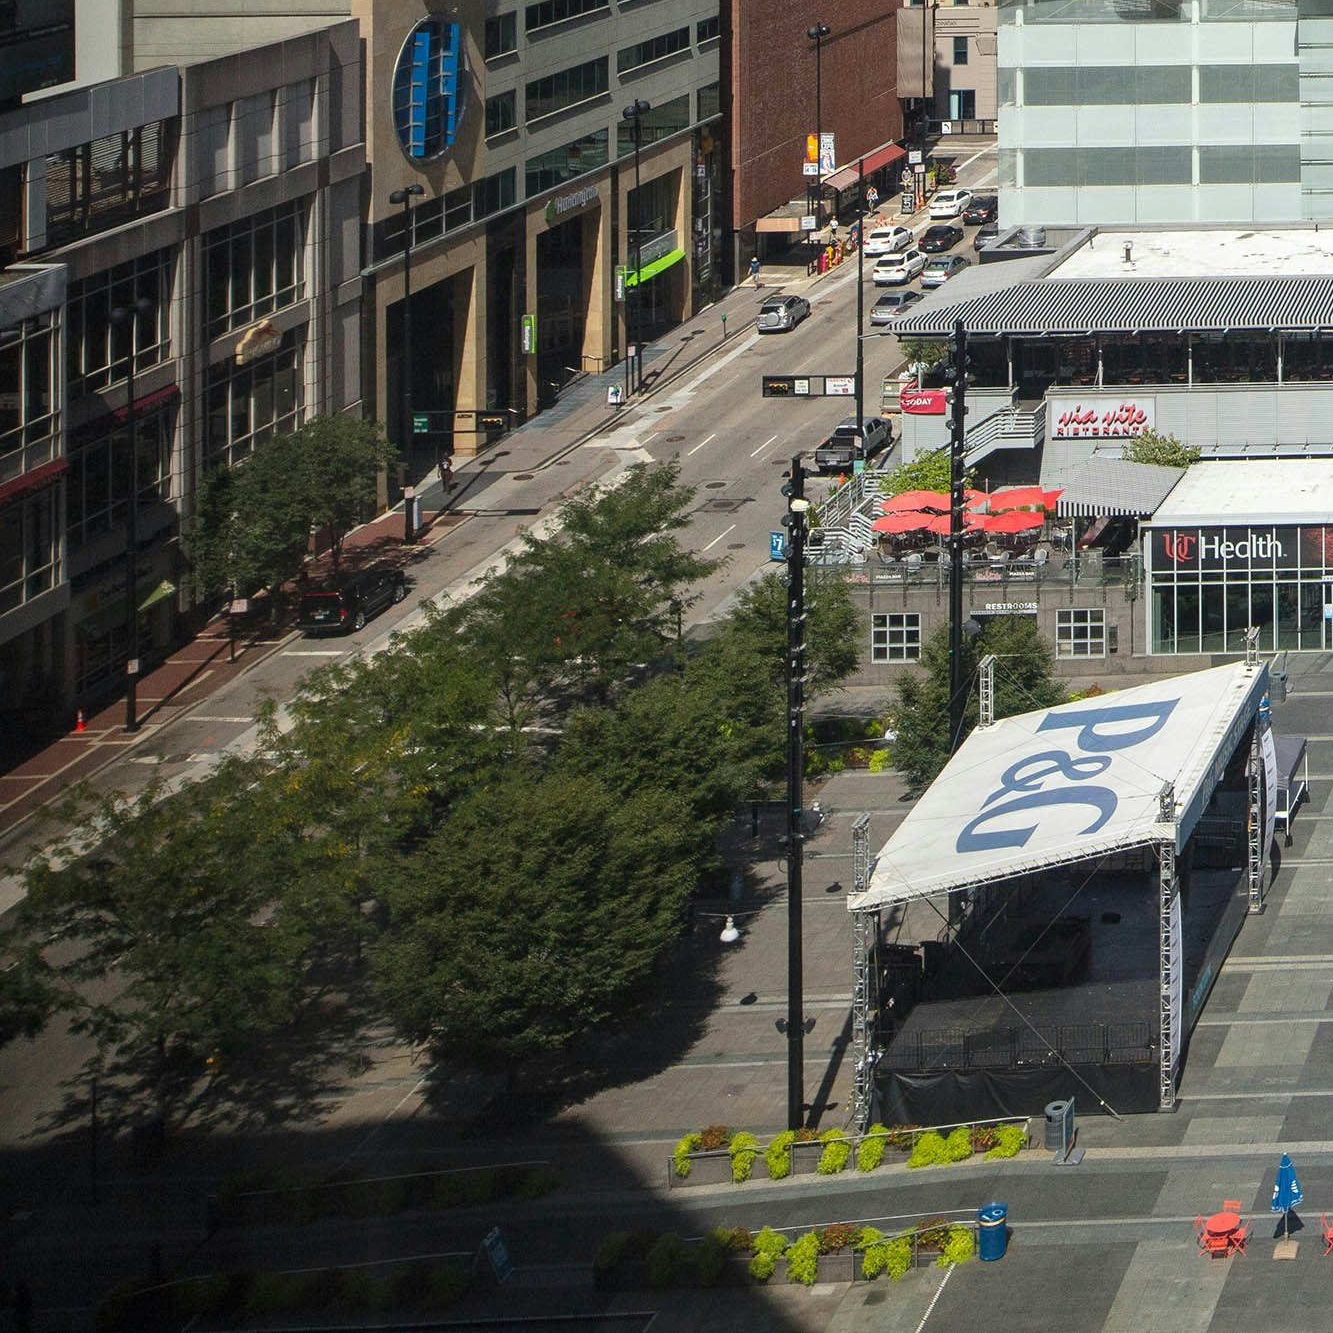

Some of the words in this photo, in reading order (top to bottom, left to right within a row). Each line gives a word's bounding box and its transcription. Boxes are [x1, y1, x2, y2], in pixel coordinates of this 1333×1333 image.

[1058, 404, 1098, 426] via
[1101, 403, 1147, 426] vite
[985, 602, 1038, 610] RESTROOMS
